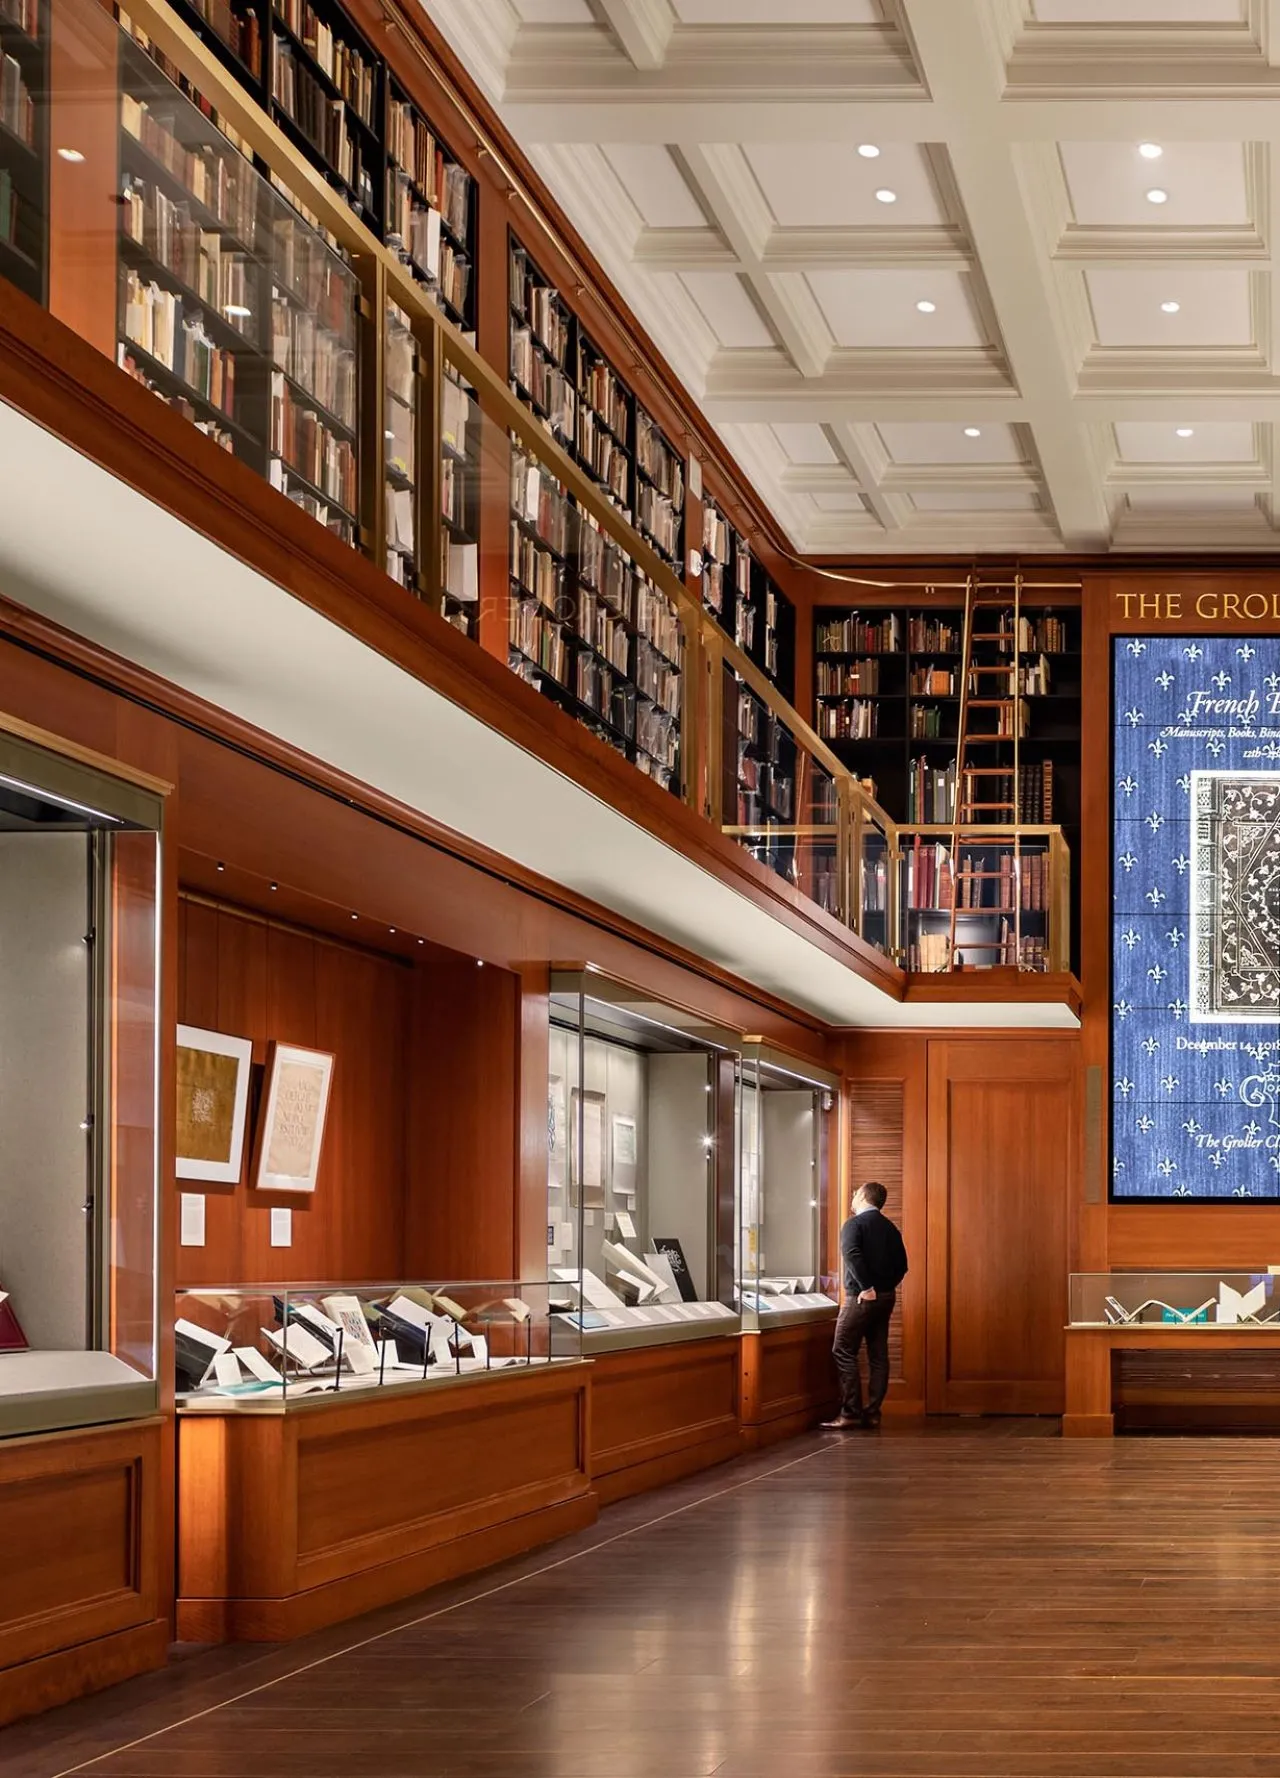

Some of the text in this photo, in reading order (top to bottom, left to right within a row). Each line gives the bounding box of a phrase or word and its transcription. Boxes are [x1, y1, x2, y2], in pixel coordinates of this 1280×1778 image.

[1116, 593, 1183, 620] THE
[1187, 690, 1259, 715] French
[1160, 726, 1226, 740] Manuscripts,
[1228, 726, 1257, 739] Books,
[1176, 1037, 1236, 1051] December
[1195, 1134, 1220, 1149] The
[1222, 1133, 1263, 1152] Grolier
